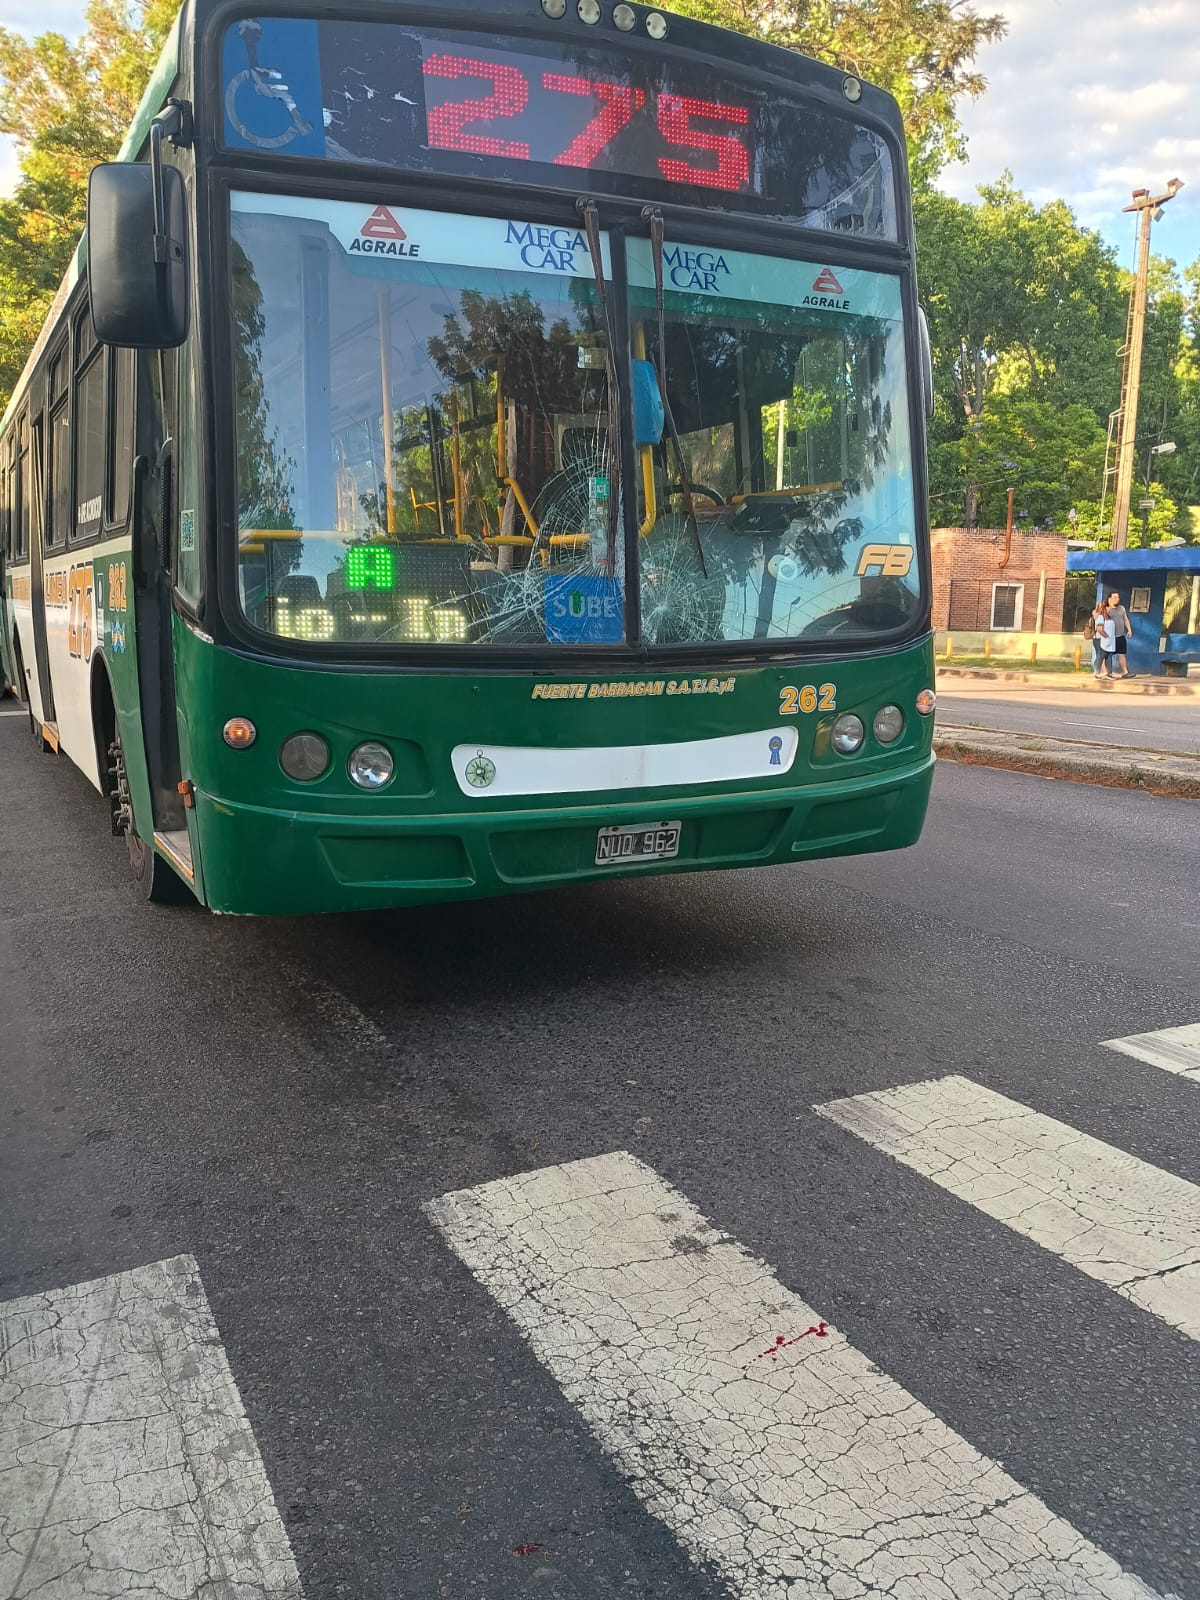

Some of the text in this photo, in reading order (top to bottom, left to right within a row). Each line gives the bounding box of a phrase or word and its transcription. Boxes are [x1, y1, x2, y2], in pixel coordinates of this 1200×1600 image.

[423, 53, 748, 190] 275
[350, 238, 420, 258] AGRALE
[504, 220, 592, 253] MEGA
[521, 244, 578, 272] CAR
[663, 246, 733, 275] MEGA
[670, 267, 720, 293] CAR
[802, 295, 851, 311] AGRALE
[347, 546, 394, 588] A
[854, 543, 914, 577] FB
[108, 562, 127, 612] 262
[69, 561, 93, 663] 275
[552, 590, 617, 618] SUBE
[531, 683, 588, 700] FUERTE
[588, 681, 666, 698] BARRAGAN
[779, 683, 836, 715] 262
[643, 830, 677, 853] 962
